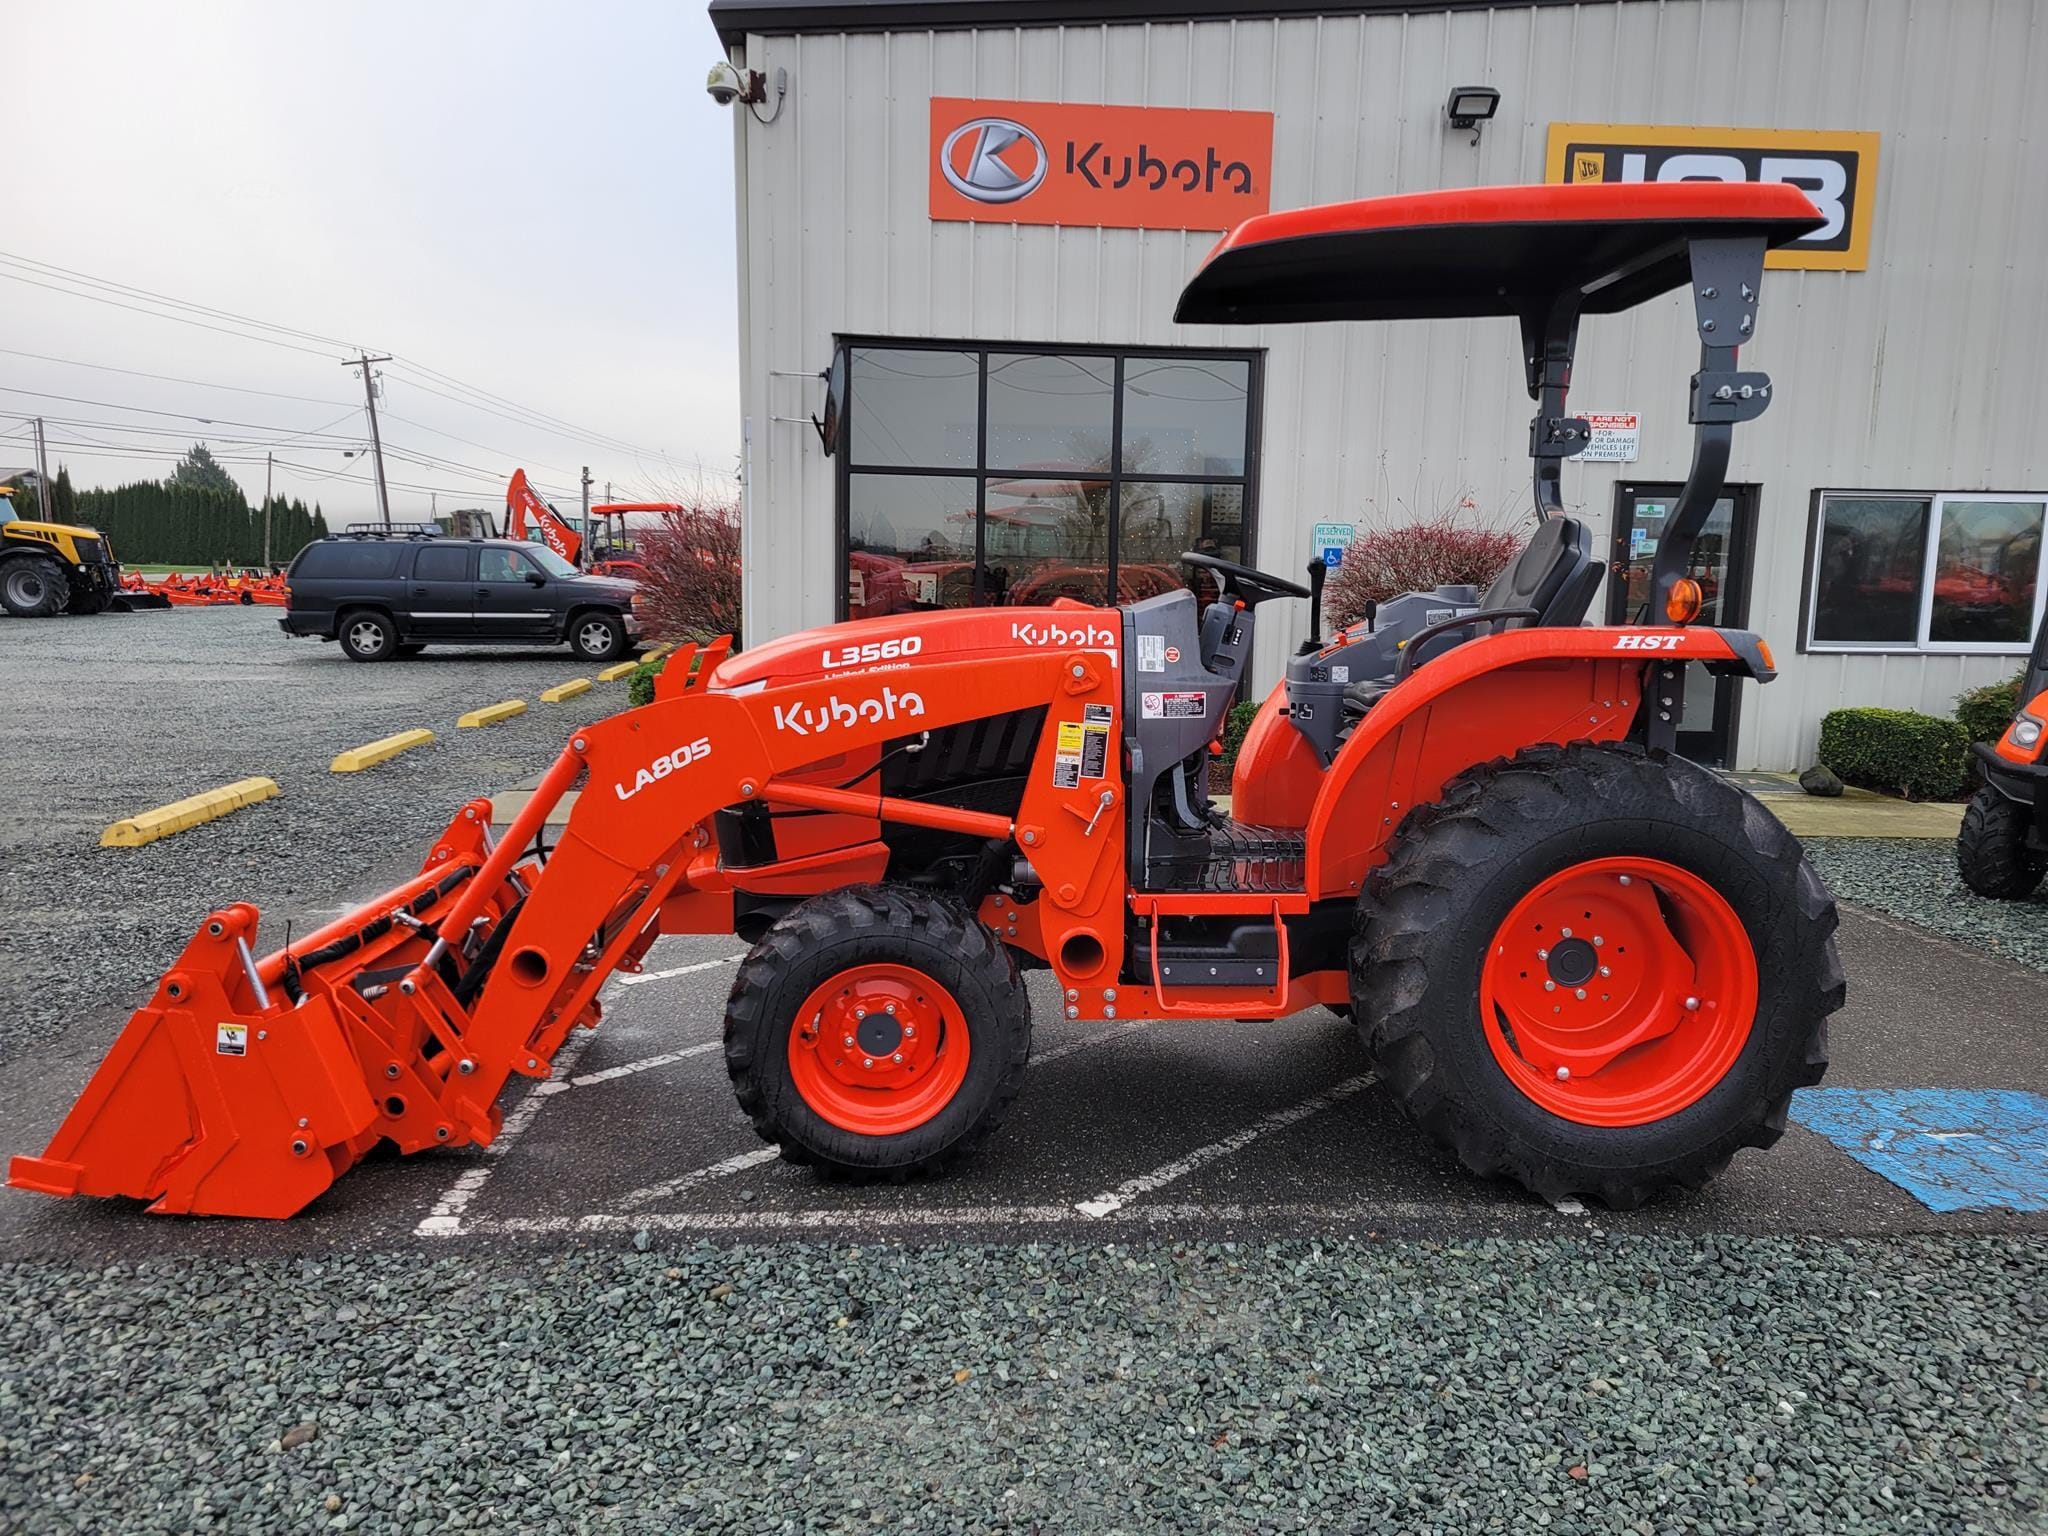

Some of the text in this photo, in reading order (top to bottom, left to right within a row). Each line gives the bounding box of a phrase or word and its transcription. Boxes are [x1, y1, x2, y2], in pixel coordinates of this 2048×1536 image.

[1065, 141, 1251, 194] Kubota
[1579, 160, 1600, 179] JCB
[539, 515, 567, 556] Kubota
[1317, 527, 1351, 536] RESERVED
[1011, 622, 1115, 646] Kubota
[1612, 635, 1686, 650] HST
[822, 636, 922, 669] L3560
[773, 687, 925, 735] Kubota
[614, 736, 712, 801] LA805
